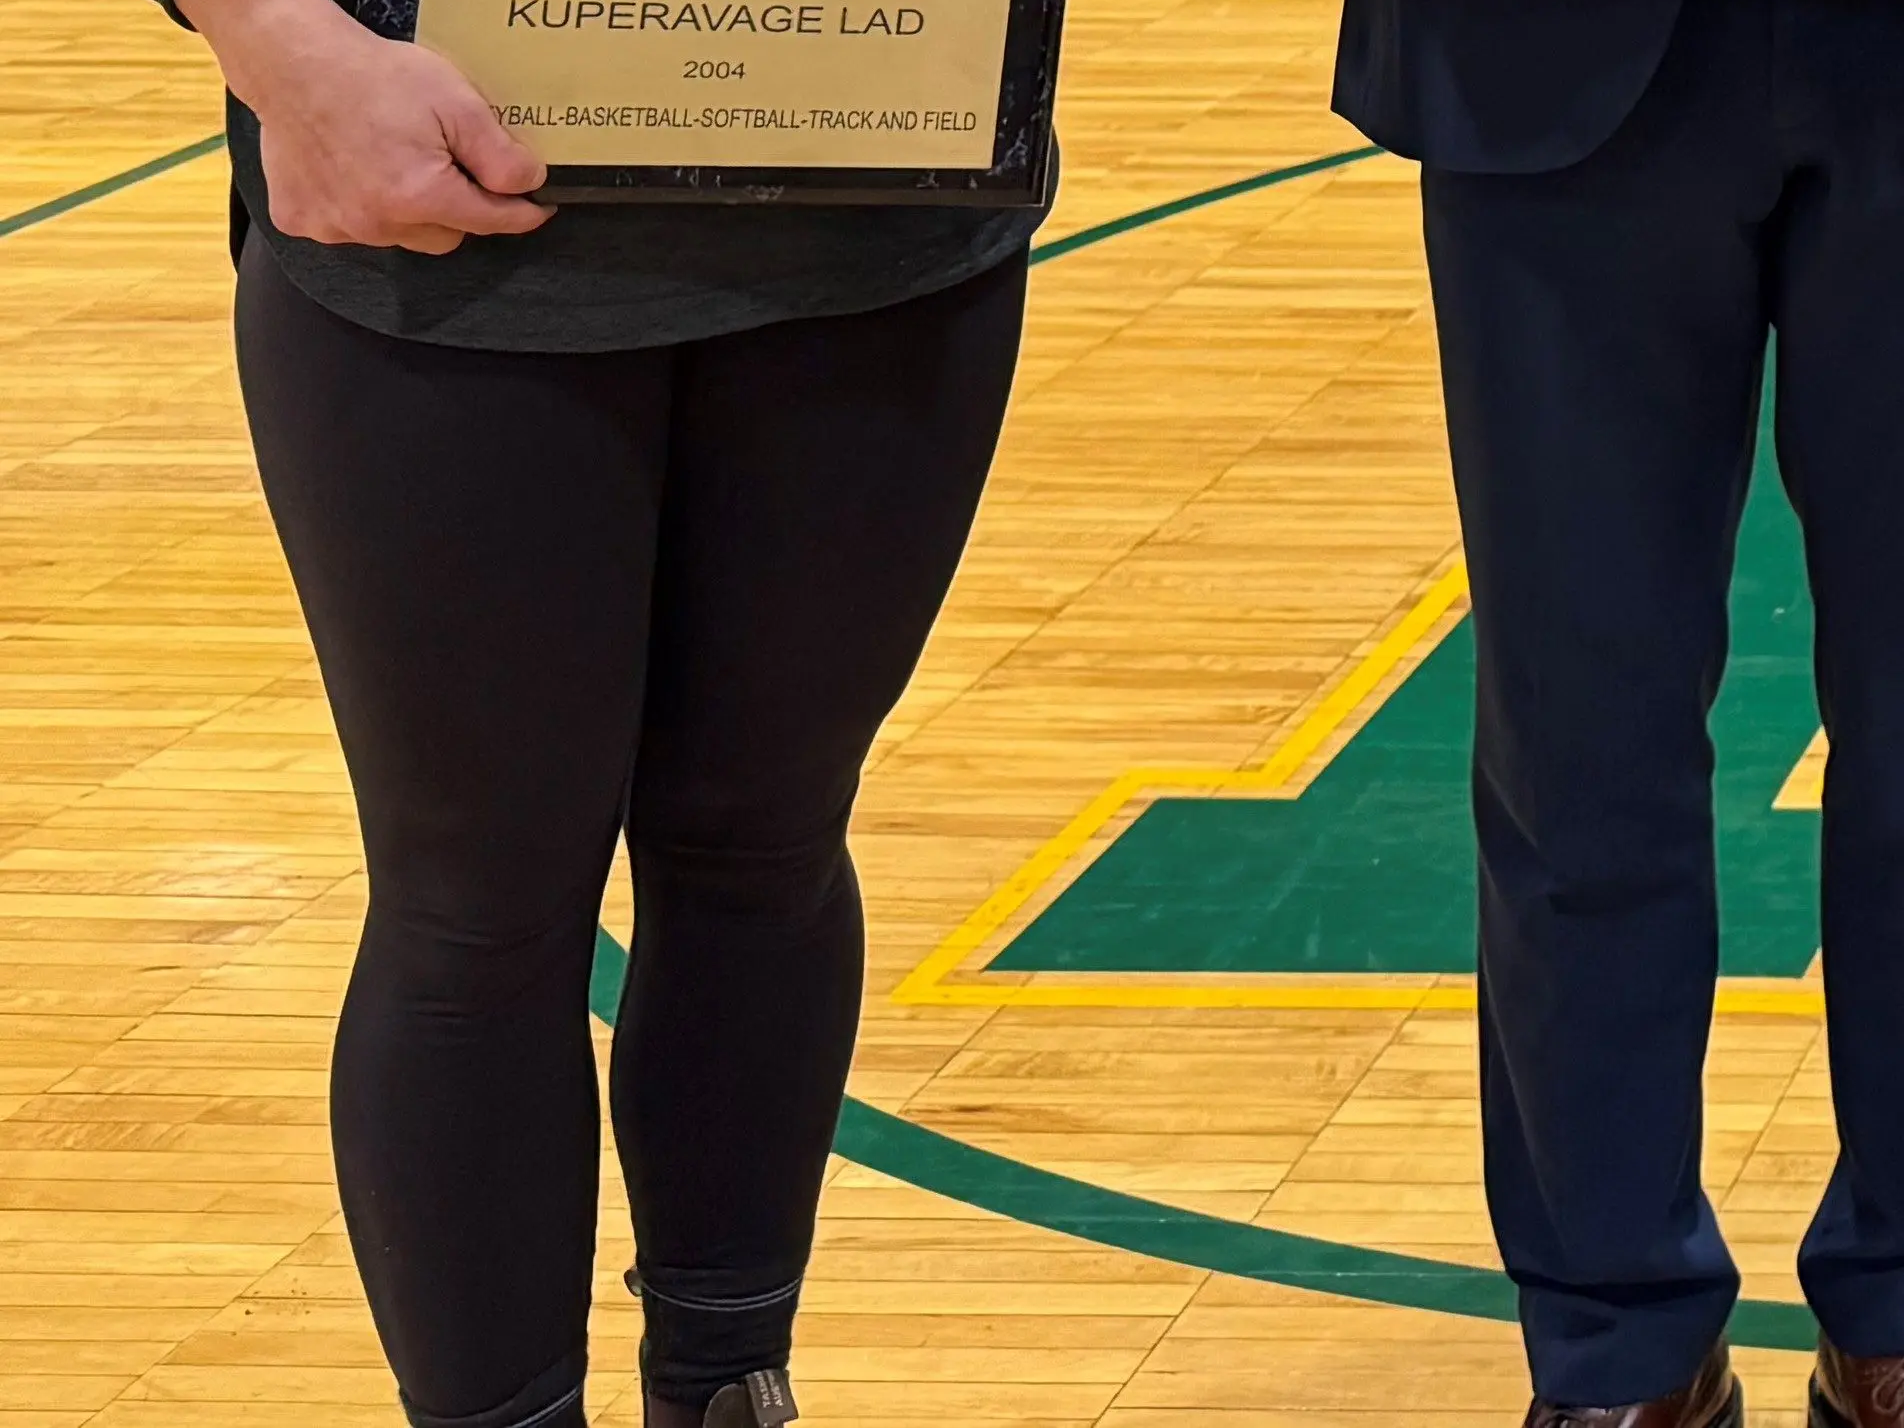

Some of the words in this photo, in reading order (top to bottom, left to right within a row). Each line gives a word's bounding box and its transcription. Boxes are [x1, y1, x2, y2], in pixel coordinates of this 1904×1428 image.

[508, 0, 824, 33] KUPERAVAGE
[840, 7, 924, 35] LAD
[683, 60, 746, 79] 2004
[489, 105, 874, 130] YBALL-BASKETBALL-SOFTBALL-TRACK
[876, 110, 918, 131] AND
[922, 110, 977, 132] FIELD
